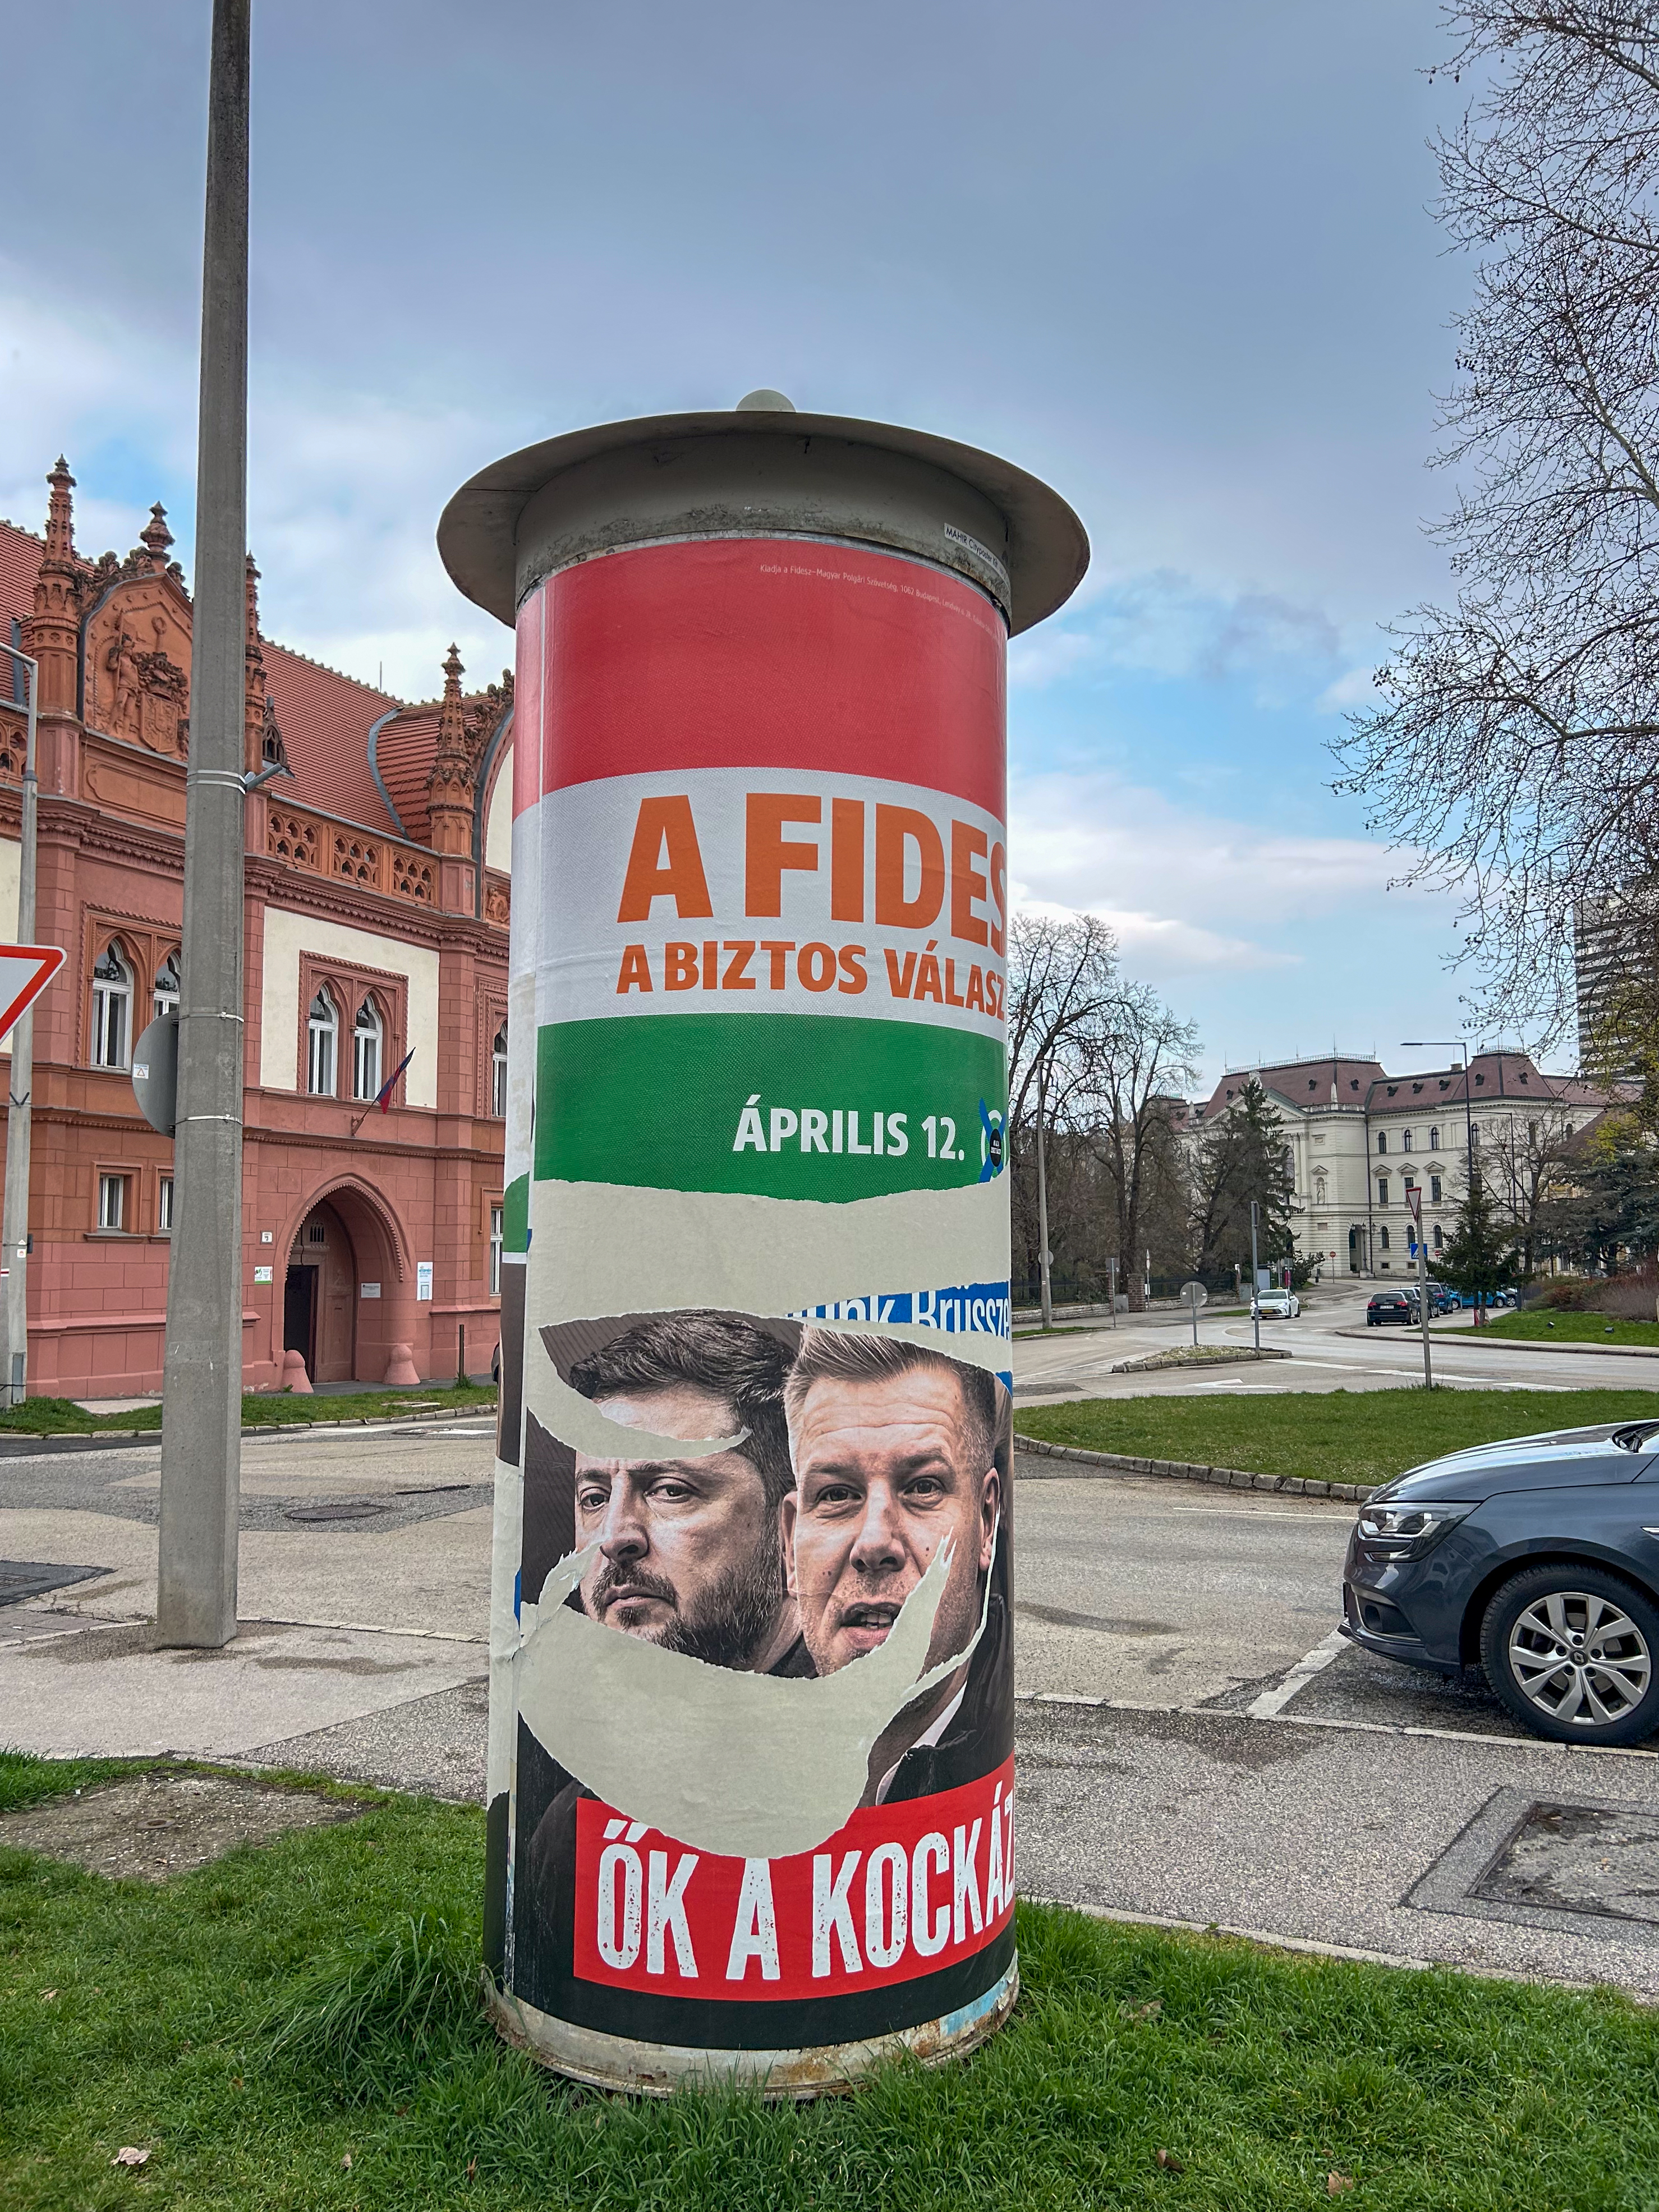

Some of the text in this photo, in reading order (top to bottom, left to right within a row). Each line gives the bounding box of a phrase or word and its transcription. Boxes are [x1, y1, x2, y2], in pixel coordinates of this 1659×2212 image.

[946, 526, 967, 545] MAHIR
[760, 564, 782, 574] Kiadja
[843, 572, 865, 584] Polgári
[900, 585, 914, 595] 1062
[617, 793, 1005, 958] A FIDES
[617, 944, 653, 994] A
[664, 940, 868, 995] BIZTOS
[733, 1094, 964, 1161] ÁPRILIS 12.
[598, 1819, 699, 1978] ŐK
[726, 1857, 780, 1980] A
